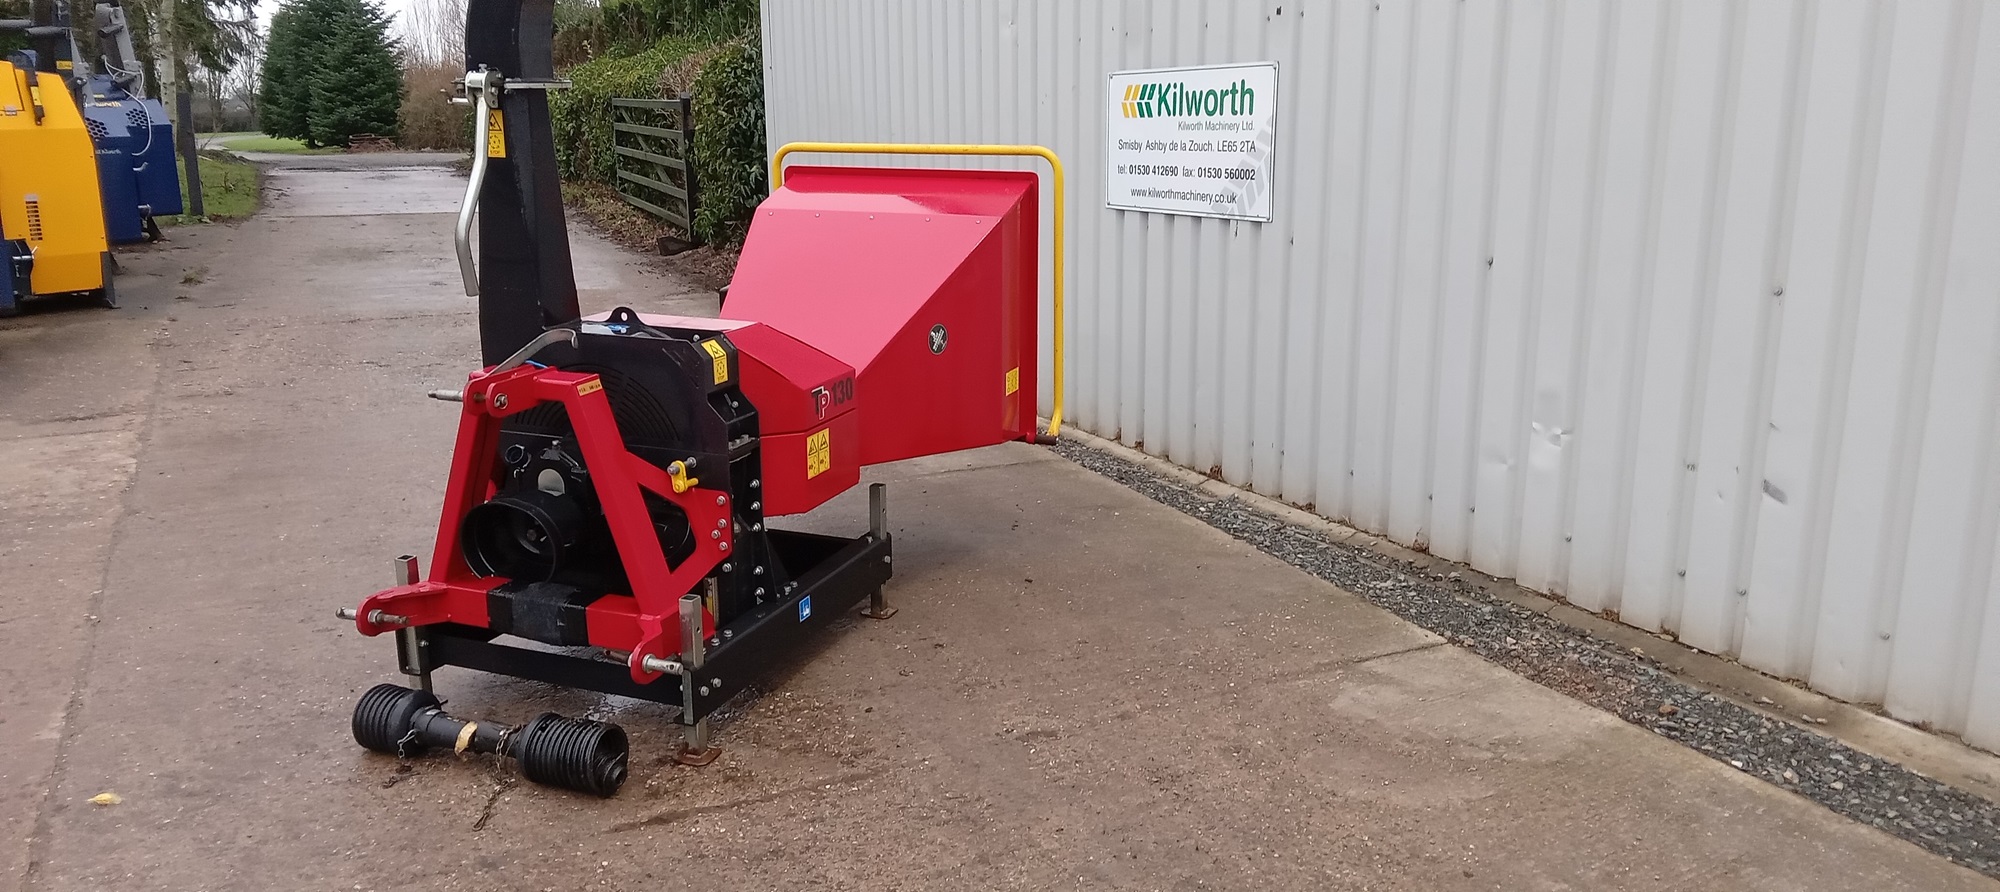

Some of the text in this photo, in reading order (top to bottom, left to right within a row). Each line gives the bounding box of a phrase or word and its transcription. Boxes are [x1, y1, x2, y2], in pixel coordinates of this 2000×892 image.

[1157, 78, 1255, 117] Kilworth
[1178, 121, 1254, 133] Kilworth Machinery Ltd.
[1118, 139, 1256, 153] Smisby Ashby de la Zouch. LE65 2TA
[1118, 165, 1255, 180] tel: 01530 412690 fax: 01530 560002
[1130, 188, 1237, 205] www.kilworthmachinery.co.uk
[831, 377, 853, 405] 130
